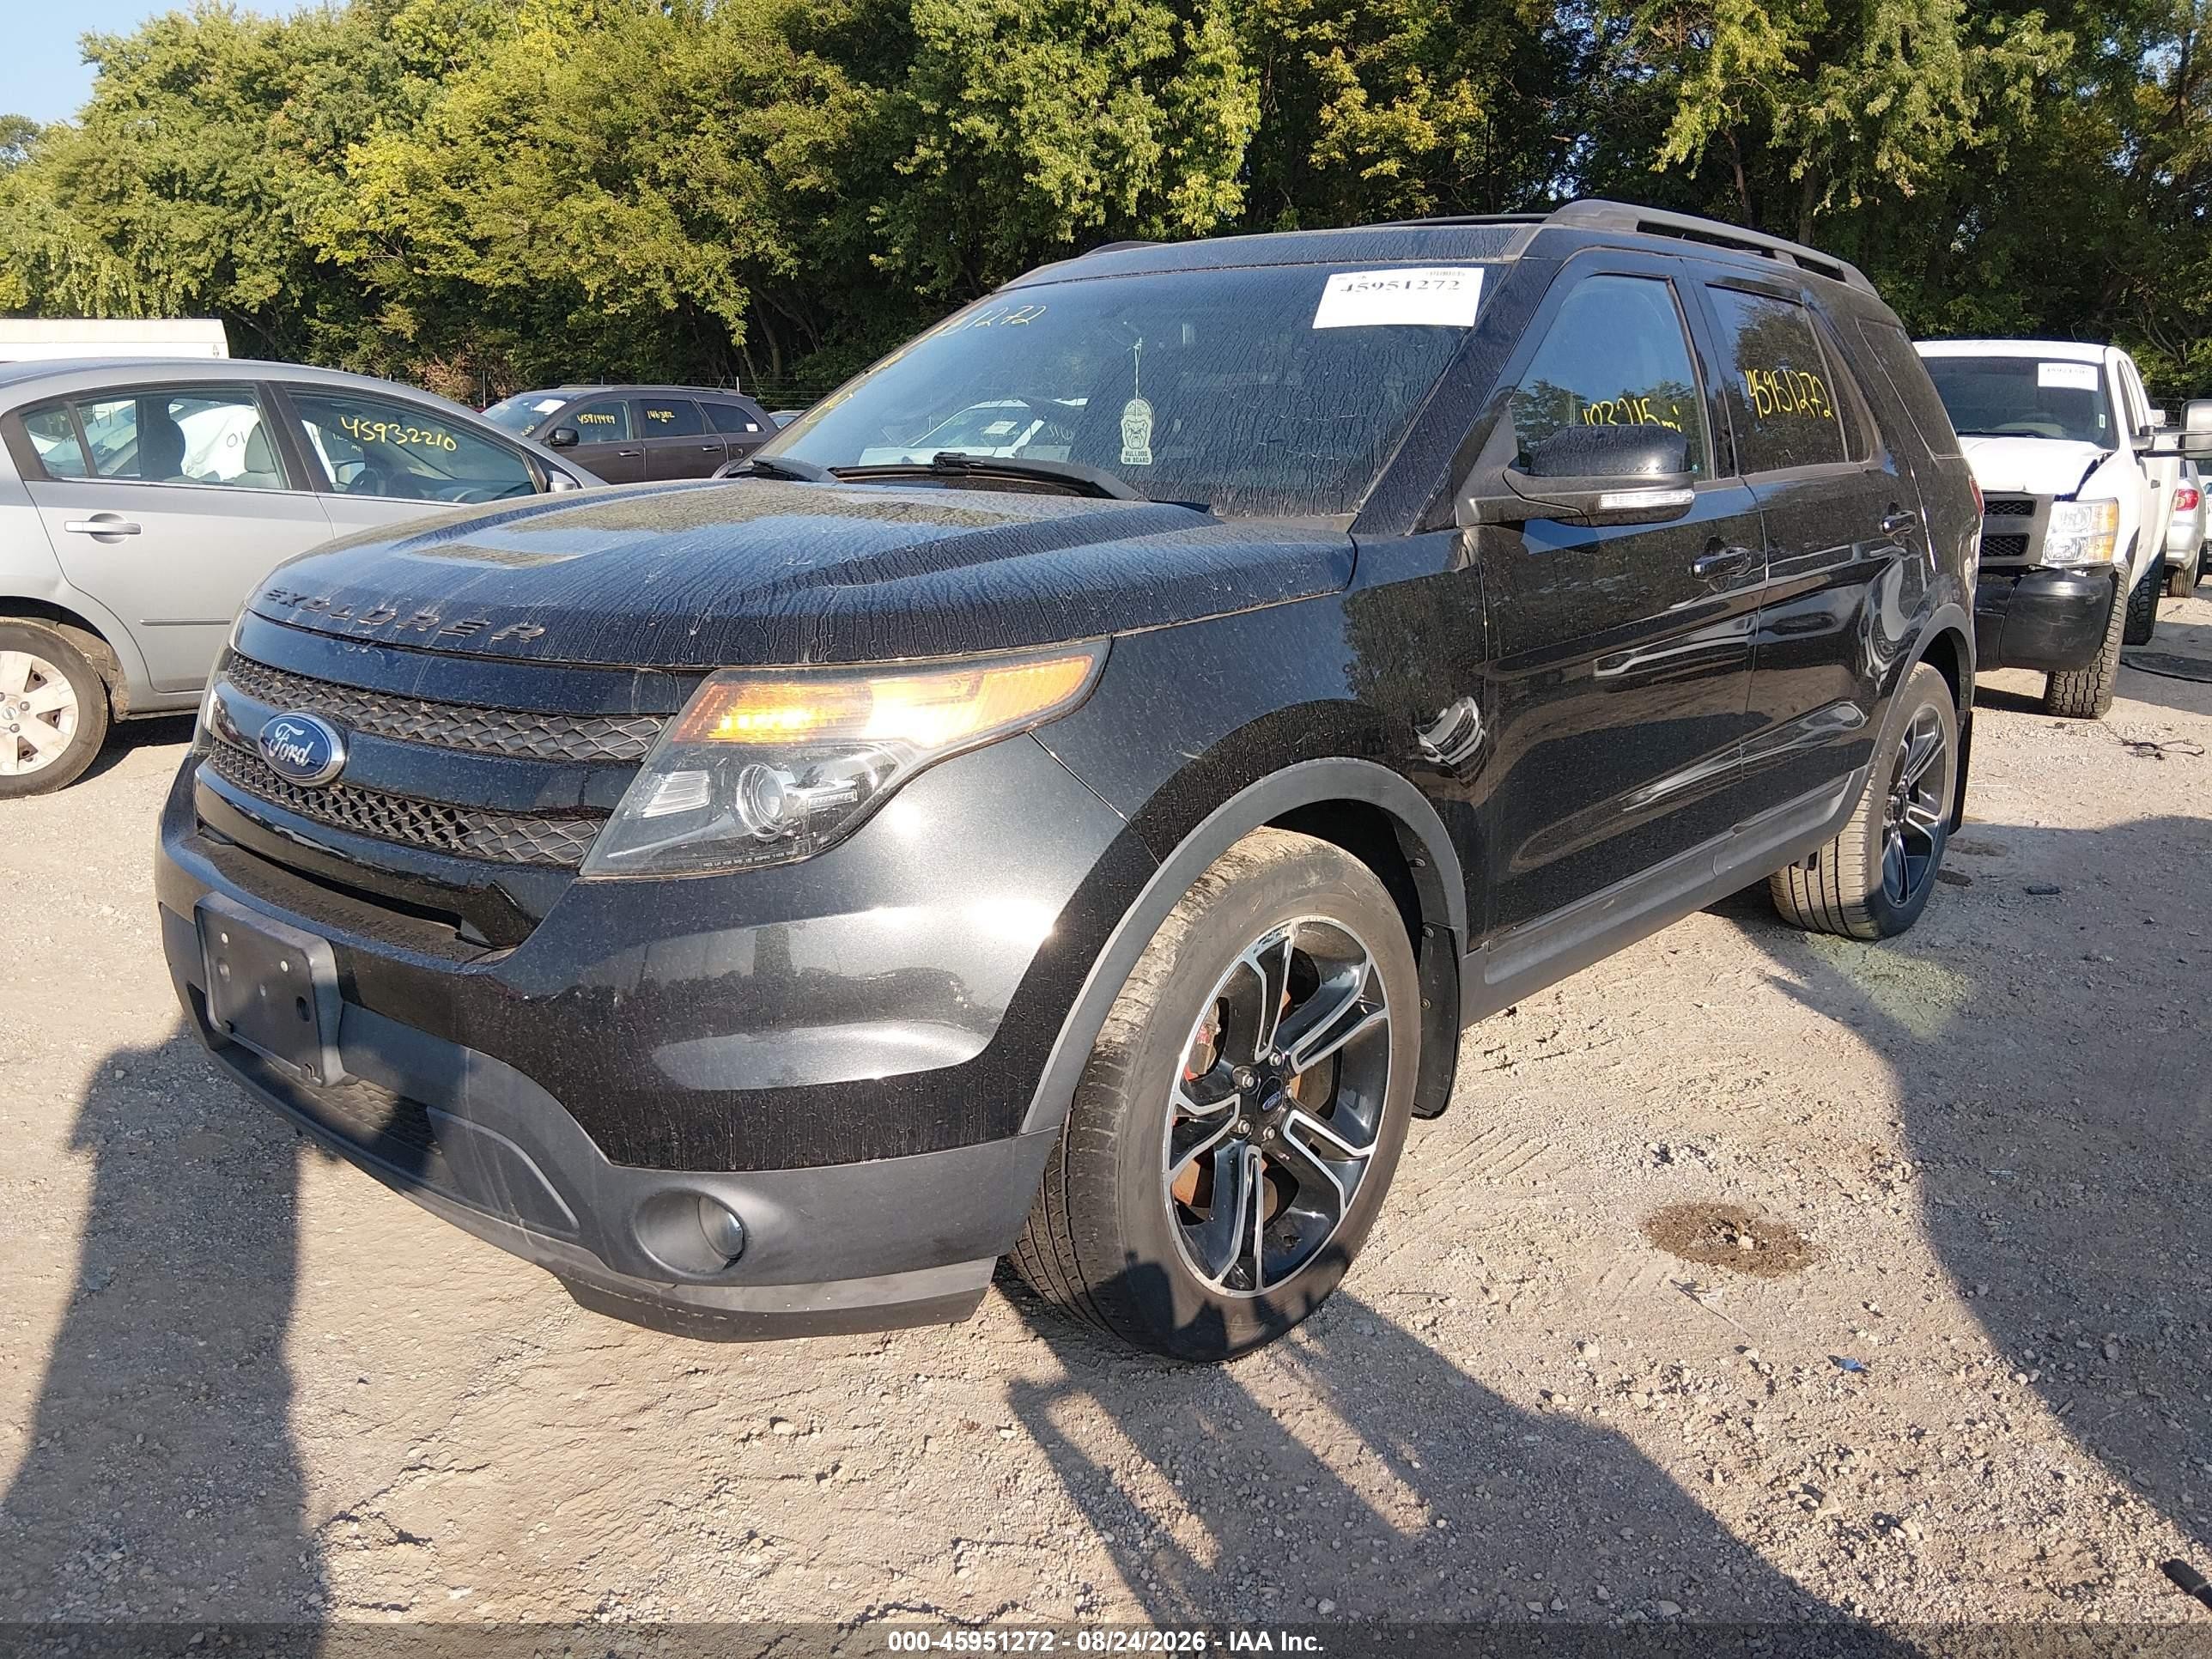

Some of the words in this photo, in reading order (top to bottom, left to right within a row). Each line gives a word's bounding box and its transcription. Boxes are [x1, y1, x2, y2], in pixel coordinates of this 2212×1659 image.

[1340, 280, 1461, 293] 45951272
[340, 416, 458, 452] 45932210
[264, 588, 545, 643] EXPLORER
[268, 722, 315, 767] Ford
